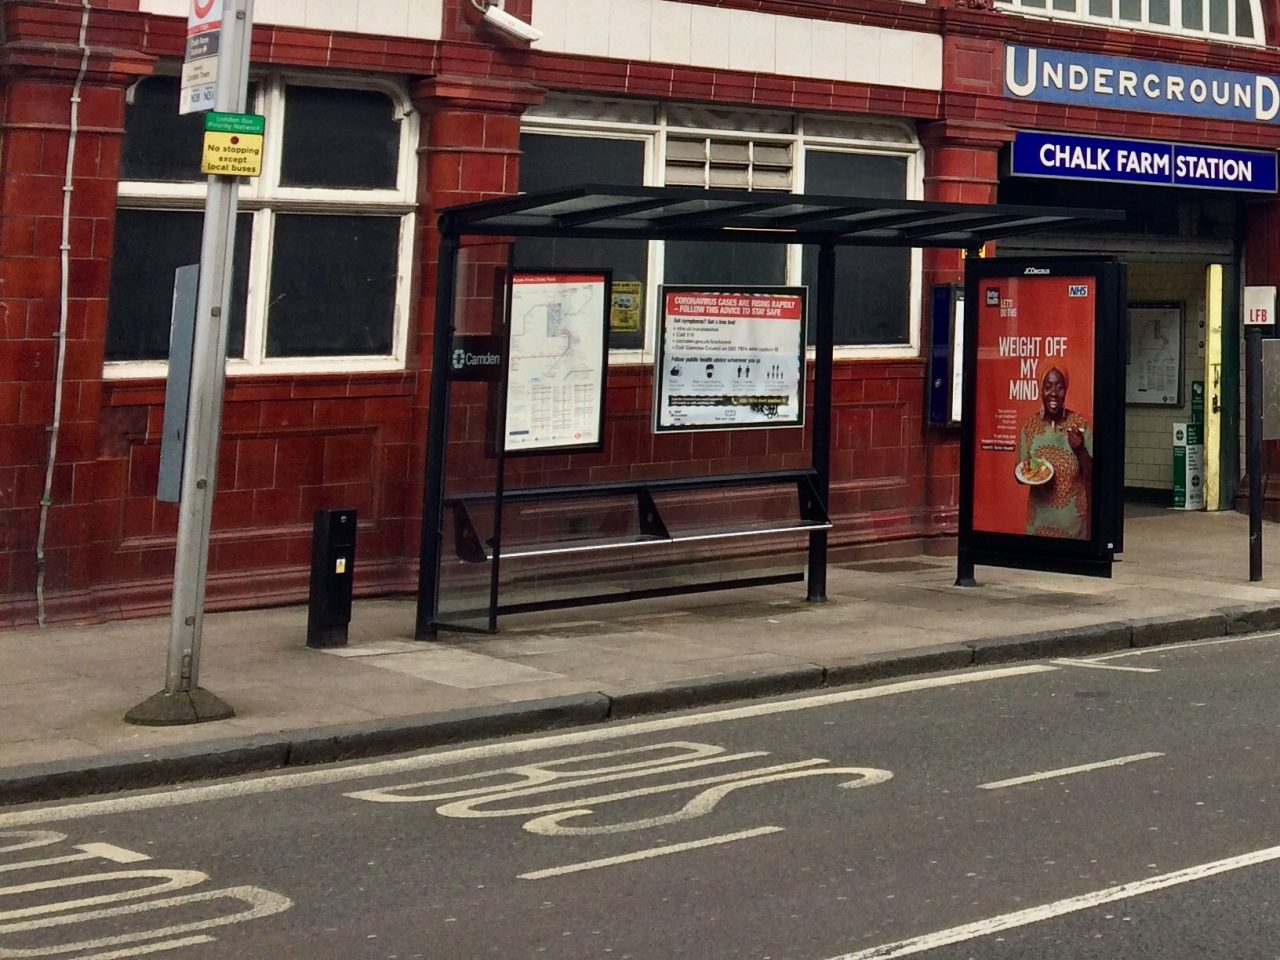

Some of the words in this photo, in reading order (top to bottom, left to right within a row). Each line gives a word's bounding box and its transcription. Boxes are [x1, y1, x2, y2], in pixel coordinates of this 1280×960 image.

[1005, 46, 1280, 121] UNDERGROUND
[216, 115, 240, 123] London
[208, 121, 231, 131] Priority
[233, 123, 261, 131] Network
[207, 144, 220, 152] No
[223, 147, 259, 156] stopping
[218, 156, 247, 164] except
[1039, 143, 1111, 171] CHALK
[1117, 150, 1170, 176] FARM
[1176, 155, 1252, 182] STATION
[207, 163, 229, 171] local
[231, 165, 256, 173] buses
[1024, 267, 1050, 275] JCDecaux
[1069, 286, 1086, 296] NHS
[675, 296, 717, 306] CORONAVIRUS
[718, 298, 737, 307] CASES
[751, 299, 770, 308] RISING
[771, 300, 796, 309] RAPIDLY
[680, 305, 705, 313] FOLLOW
[706, 306, 719, 314] THIS
[720, 306, 742, 315] ADVICE
[742, 307, 750, 315] TO
[751, 307, 765, 315] STAY
[766, 308, 782, 316] SAFE
[1250, 308, 1267, 322] LFB
[999, 336, 1041, 357] WEIGHT
[1045, 337, 1068, 357] OFF
[465, 352, 500, 365] Camden
[1020, 358, 1038, 379] MY
[1009, 380, 1039, 401] MIND
[341, 741, 895, 836] BUS
[0, 830, 294, 960] TOP
